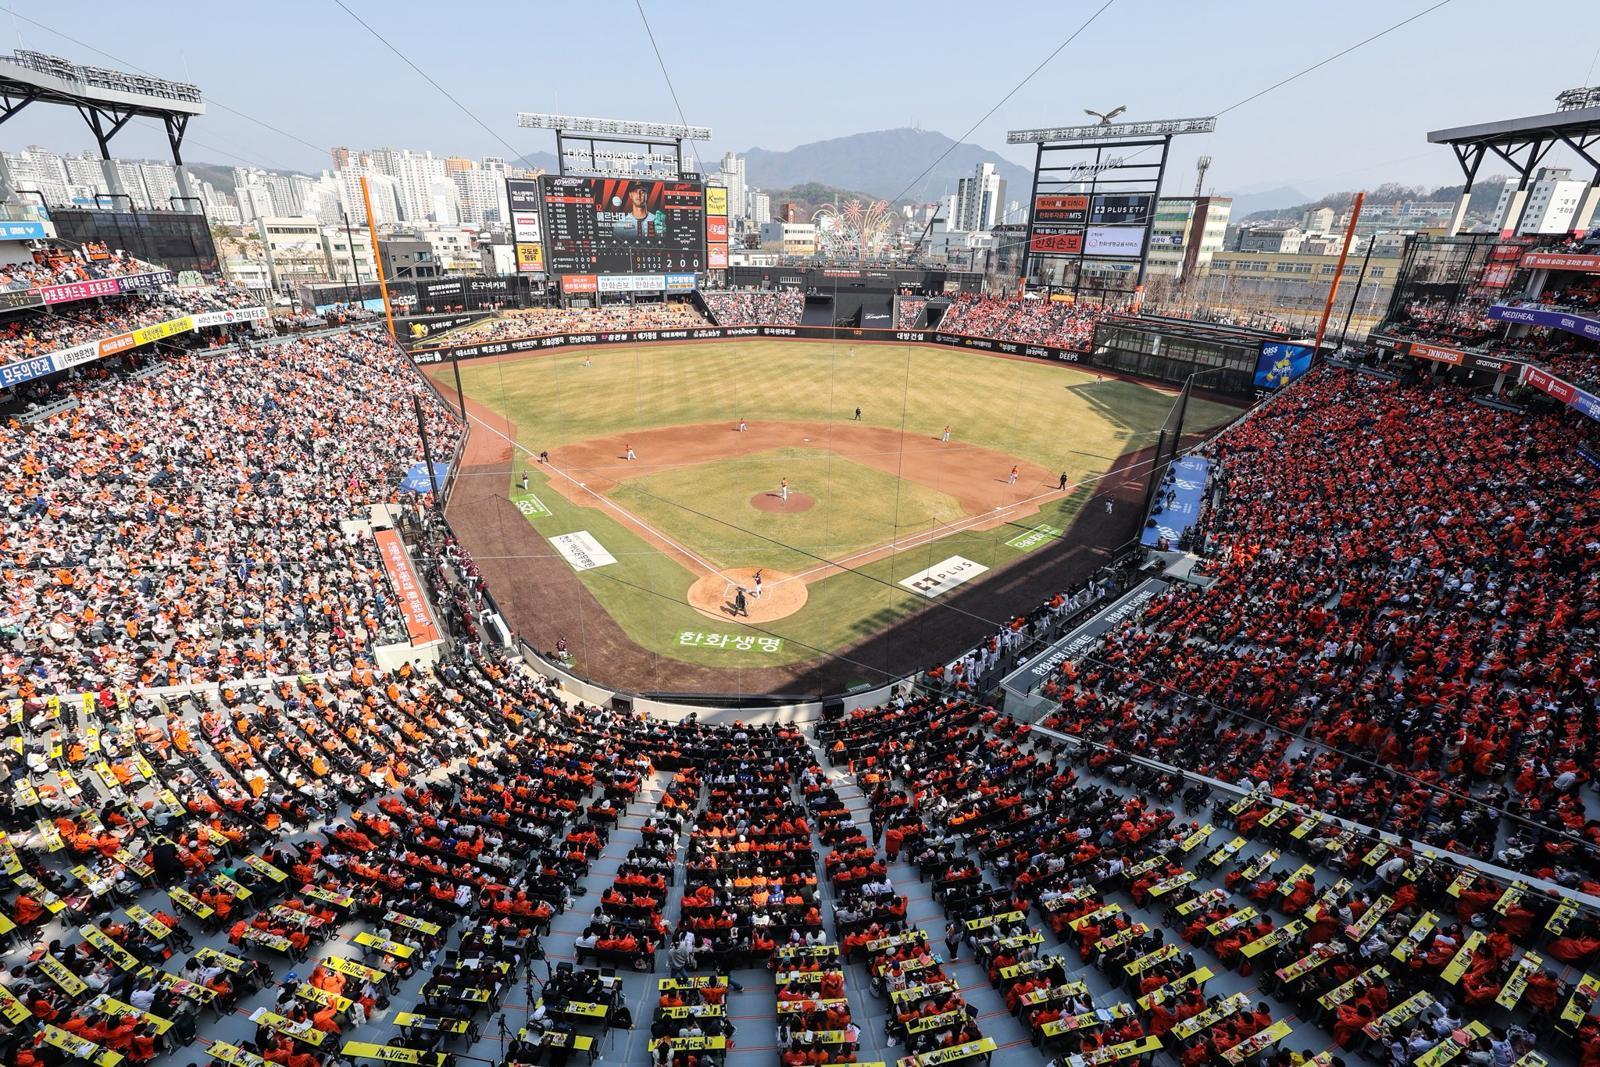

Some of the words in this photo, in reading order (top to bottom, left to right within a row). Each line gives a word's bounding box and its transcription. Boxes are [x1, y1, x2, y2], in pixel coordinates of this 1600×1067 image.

[594, 150, 638, 166] 한화생명
[1035, 237, 1078, 249] 한화손보
[667, 259, 672, 267] 2
[680, 259, 685, 267] 0
[693, 259, 699, 267] 0
[398, 296, 417, 306] GS25
[1502, 311, 1534, 321] MEDIHEAL
[896, 332, 924, 341] 대방건설
[64, 346, 95, 364] (주)보은건설
[1059, 352, 1078, 362] DEEPS
[1427, 350, 1458, 361] INNINGS
[1476, 358, 1502, 369] aramark
[3, 364, 30, 384] 모두의
[32, 360, 49, 376] 안과
[936, 561, 972, 580] PLUS
[680, 631, 782, 653] 한화생명
